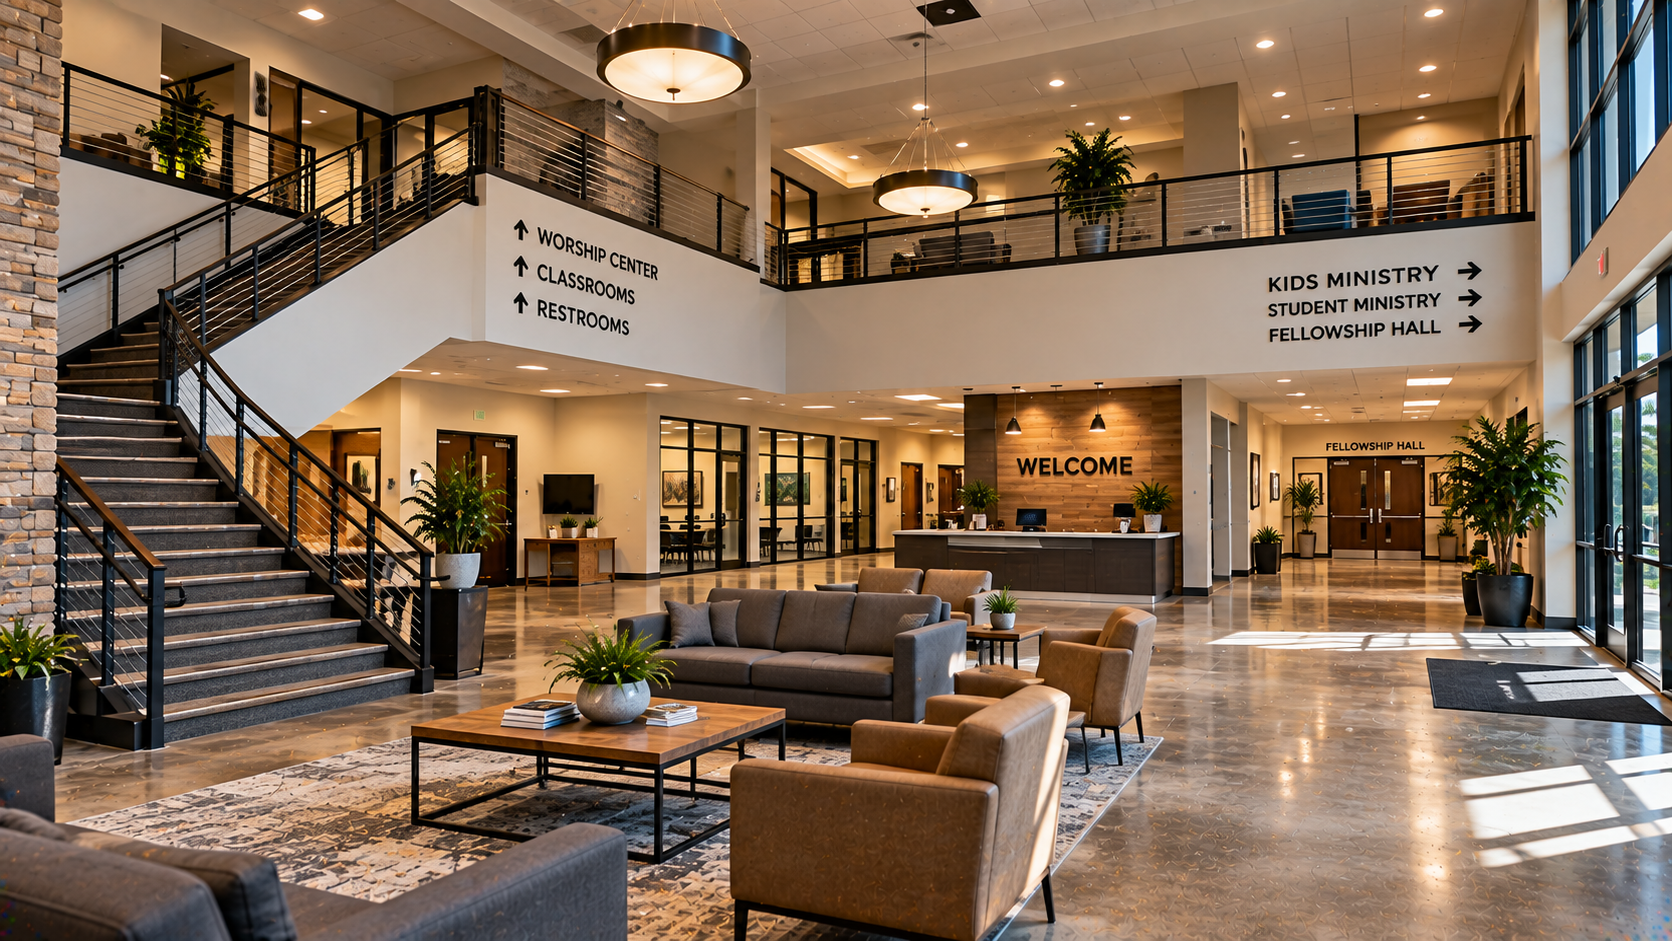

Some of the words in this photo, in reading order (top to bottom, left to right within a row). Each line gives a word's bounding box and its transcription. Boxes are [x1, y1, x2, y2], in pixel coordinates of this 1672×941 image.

[537, 226, 606, 263] WORSHIP
[609, 252, 658, 281] CENTER
[537, 264, 636, 305] CLASSROOMS
[1268, 273, 1319, 292] KIDS
[1327, 264, 1439, 288] MINISTRY
[537, 299, 630, 336] RESTROOMS
[1268, 298, 1348, 317] STUDENT
[1353, 292, 1441, 312] MINISTRY
[1269, 322, 1386, 342] FELLOWSHIP
[1391, 319, 1441, 336] HALL
[1326, 441, 1394, 451] FELLOWSHIP
[1397, 441, 1425, 450] HALL
[1016, 456, 1133, 477] WELCOME
